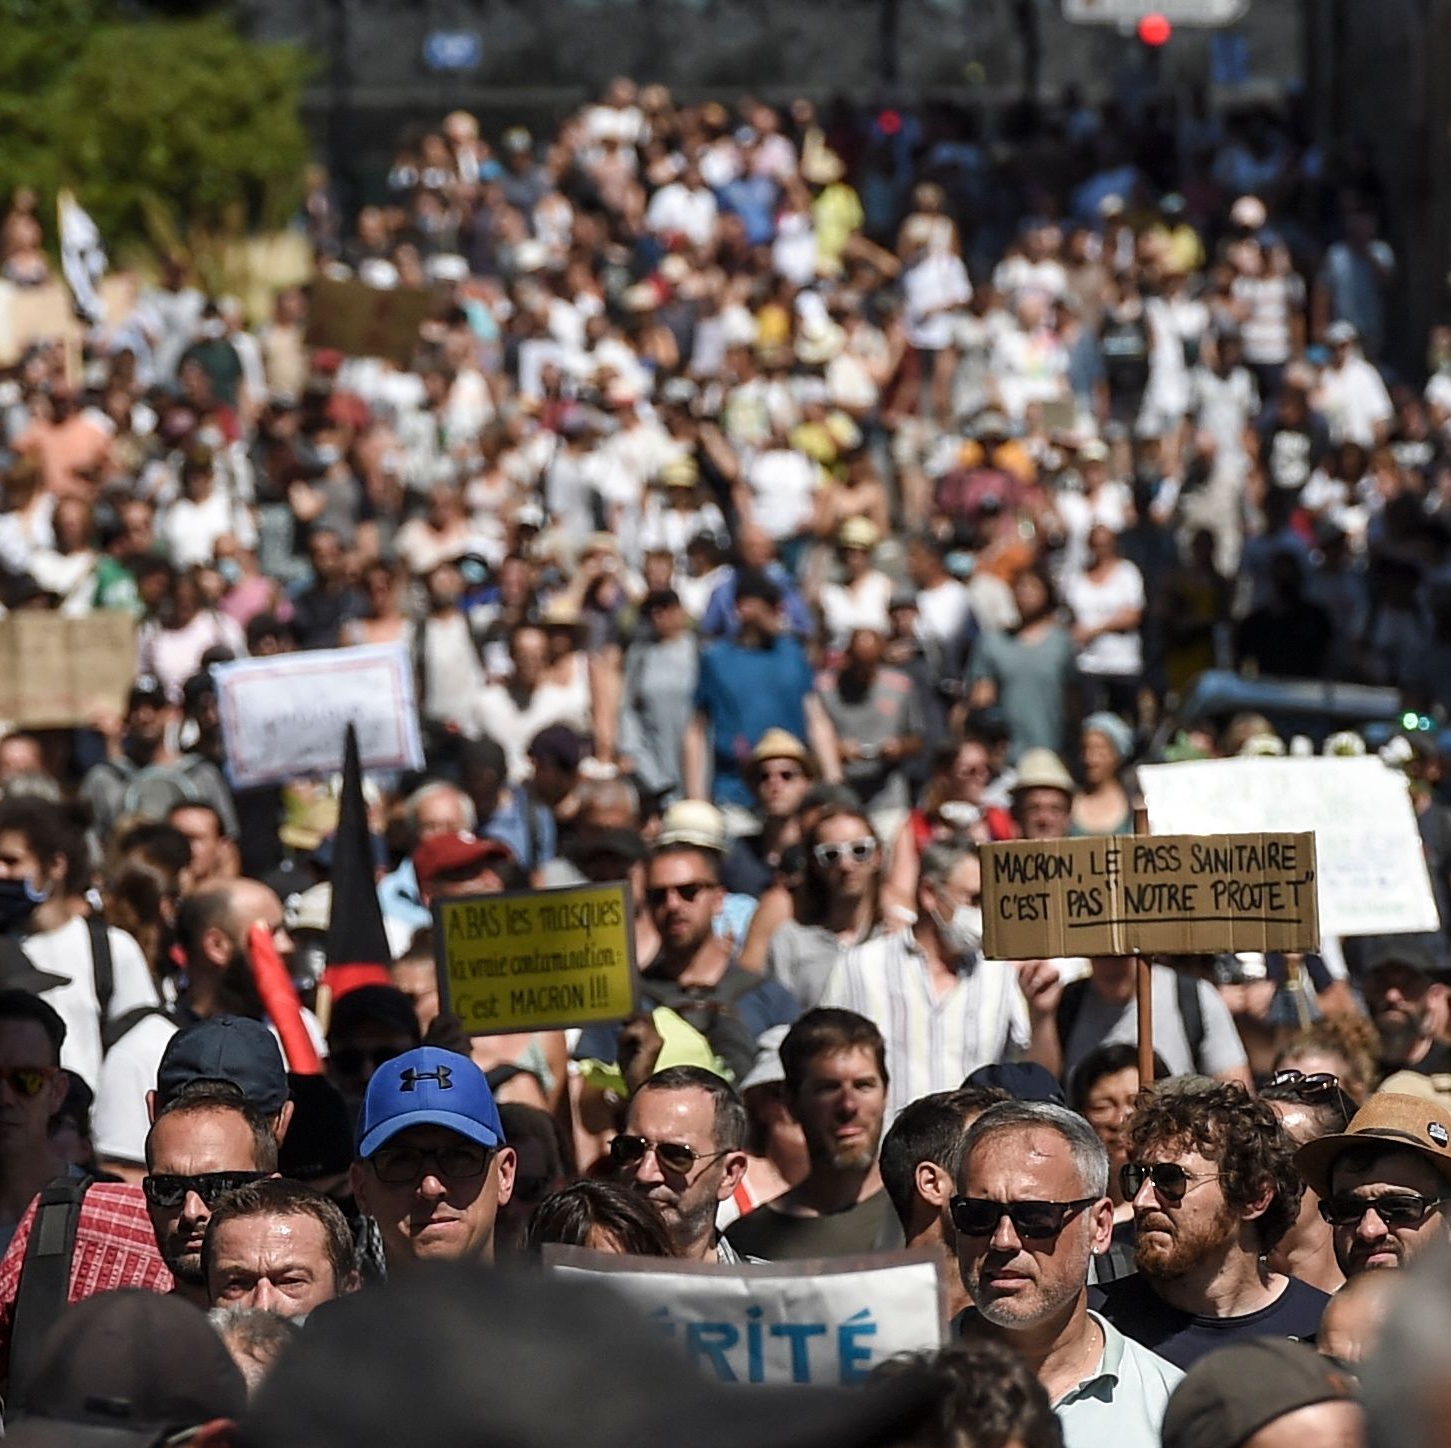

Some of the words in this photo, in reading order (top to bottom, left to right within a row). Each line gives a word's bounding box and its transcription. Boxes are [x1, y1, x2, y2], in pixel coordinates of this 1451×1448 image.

[994, 851, 1082, 883] MACRON,
[1091, 850, 1120, 875] LE
[1133, 846, 1181, 874] PASS
[1190, 844, 1297, 874] SANITAIRE
[506, 904, 533, 936] les
[539, 900, 622, 938] masques
[1000, 892, 1050, 921] C'EST
[1067, 889, 1103, 917] PAS
[511, 983, 584, 1014] MACRON
